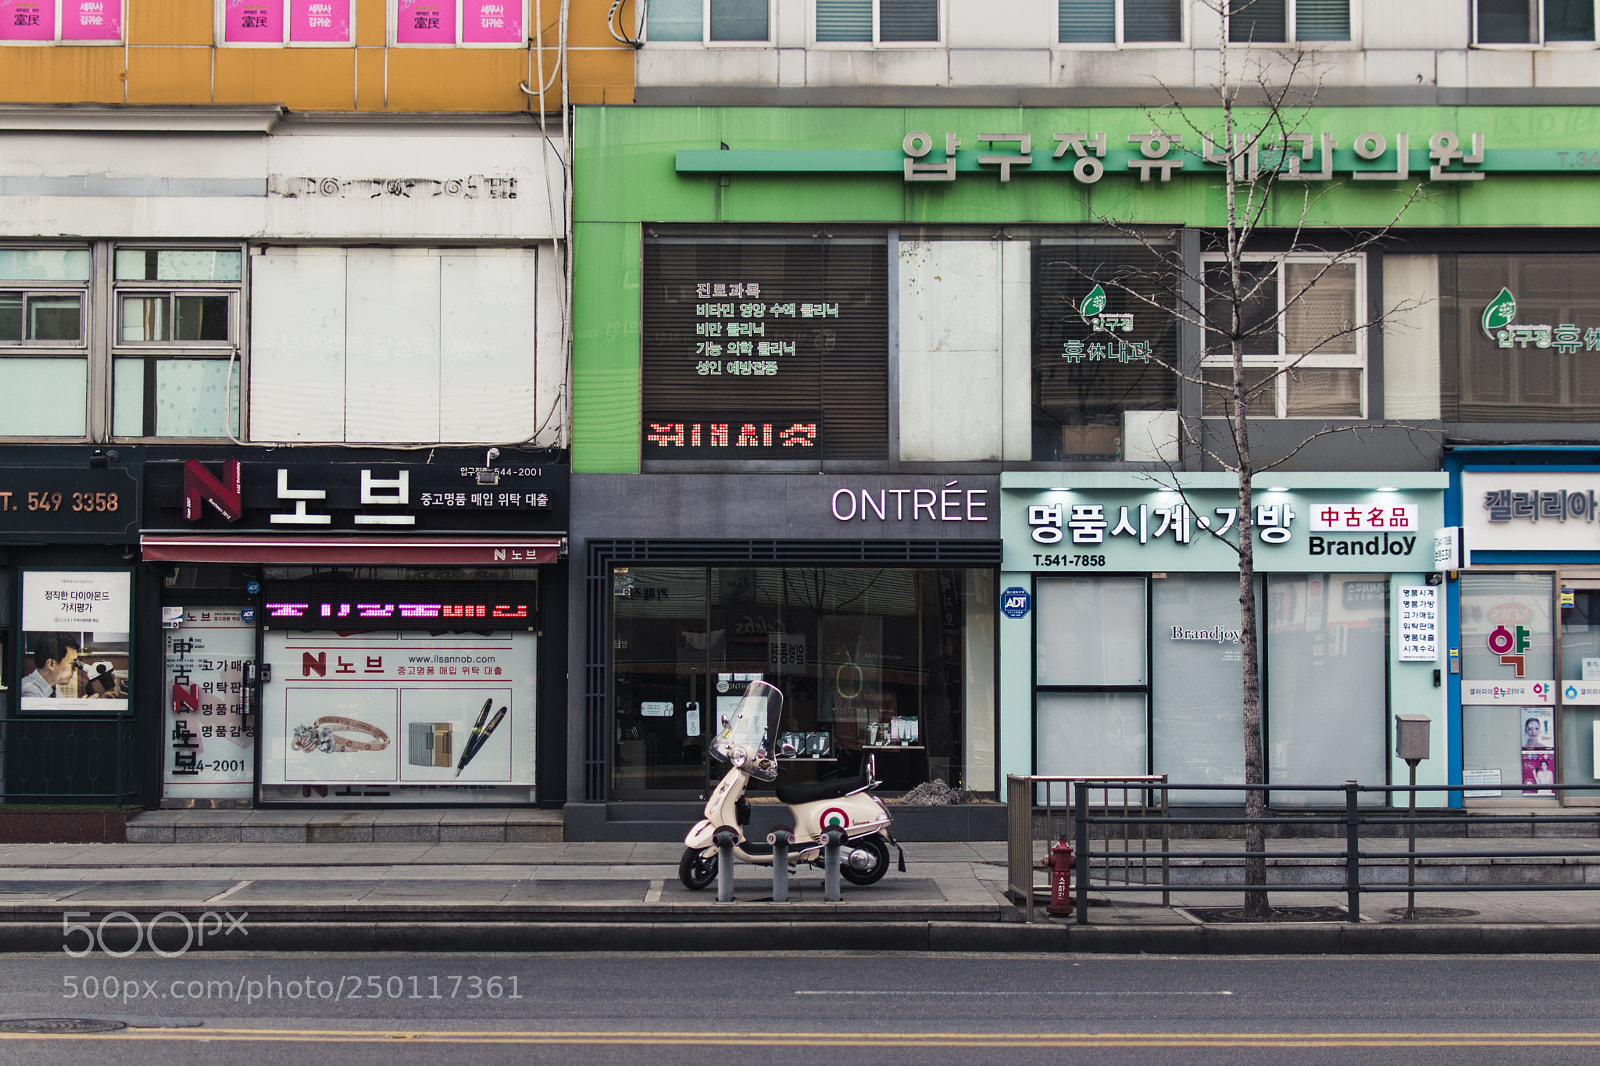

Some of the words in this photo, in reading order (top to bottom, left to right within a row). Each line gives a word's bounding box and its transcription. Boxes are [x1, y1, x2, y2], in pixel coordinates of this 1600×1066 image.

[80, 2, 103, 12] 세무사
[308, 3, 332, 14] 세무사
[481, 4, 503, 15] 세무사
[696, 282, 760, 298] 진료과목
[696, 302, 735, 318] 비타민
[740, 302, 766, 318] 영양
[770, 302, 796, 318] 수액
[800, 302, 839, 318] 클리닉
[696, 321, 722, 337] 비만
[727, 321, 765, 337] 클리닉
[1496, 324, 1552, 348] 압구정
[696, 341, 722, 356] 기능
[727, 341, 753, 356] 의학
[757, 341, 796, 356] 클리닉
[696, 360, 722, 375] 성인
[727, 360, 779, 375] 예방접종
[27, 491, 63, 512] 549
[71, 491, 119, 512] 3358
[269, 468, 416, 524] 노브
[420, 492, 467, 507] 중고명품
[471, 492, 493, 507] 매입
[498, 492, 522, 507] 위탁
[525, 492, 549, 507] 대출
[831, 479, 989, 522] ONTRÉE
[1320, 506, 1409, 528] 中古名品
[511, 549, 538, 561] 노브
[1032, 554, 1106, 568] T.541-7858
[44, 590, 69, 601] 정직한
[70, 590, 110, 601] 다이아몬드
[1005, 596, 1027, 608] ADT
[61, 602, 93, 613] 가치평가
[186, 612, 212, 622] 노브
[1402, 611, 1436, 620] 고가매입
[1402, 622, 1436, 631] 위탁판매
[1171, 625, 1242, 644] Brandjoy
[1402, 645, 1436, 654] 시계수리
[1487, 624, 1532, 679] 약
[335, 655, 385, 674] 노브
[408, 654, 496, 664] www.ilsannob.com
[398, 666, 435, 676] 중고명품
[439, 666, 457, 676] 매입
[462, 666, 480, 676] 위탁
[484, 666, 502, 676] 대출
[1057, 875, 1067, 900] 소화전
